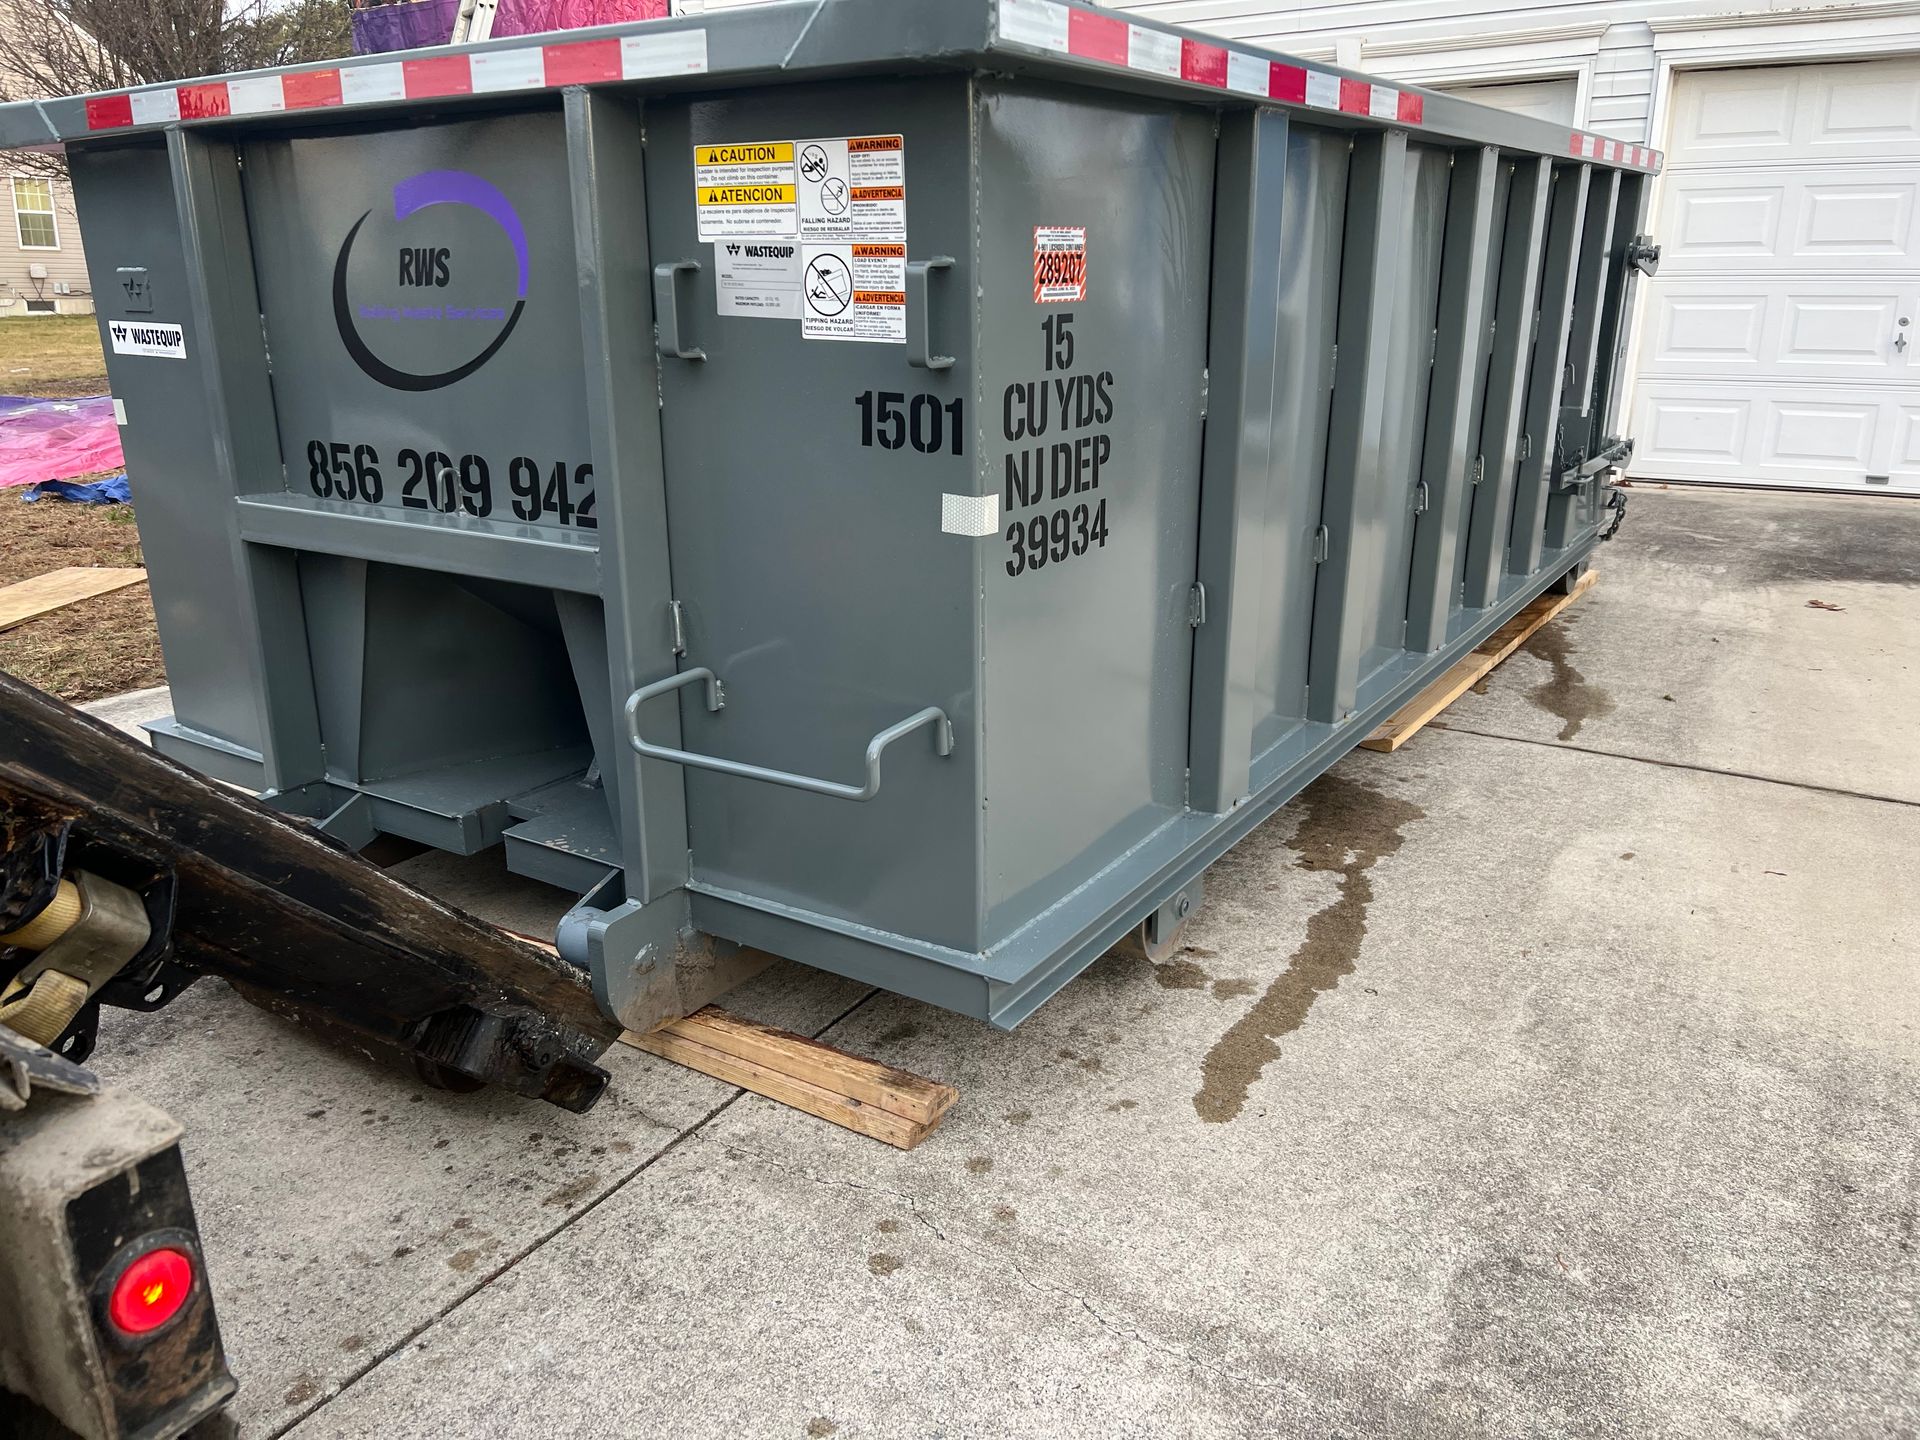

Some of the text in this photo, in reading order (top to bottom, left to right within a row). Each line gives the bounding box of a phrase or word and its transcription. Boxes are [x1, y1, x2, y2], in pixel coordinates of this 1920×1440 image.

[720, 147, 775, 162] CAUTION
[856, 139, 899, 150] WARNING
[720, 188, 782, 202] ATENCION
[859, 189, 902, 199] ADVERTENCIA
[745, 246, 794, 258] WASTEQUIP
[860, 247, 903, 255] WARNING
[400, 248, 450, 288] RWS
[1039, 254, 1082, 284] 289207
[862, 294, 904, 302] ADVERTENCIA
[130, 328, 182, 348] WASTEQUIP
[1041, 313, 1074, 371] 15
[1003, 371, 1114, 442] CU YDS
[854, 390, 963, 456] 1501
[307, 440, 598, 529] 856 209 942
[1005, 434, 1111, 512] NJ DEP
[1005, 498, 1109, 577] 39934
